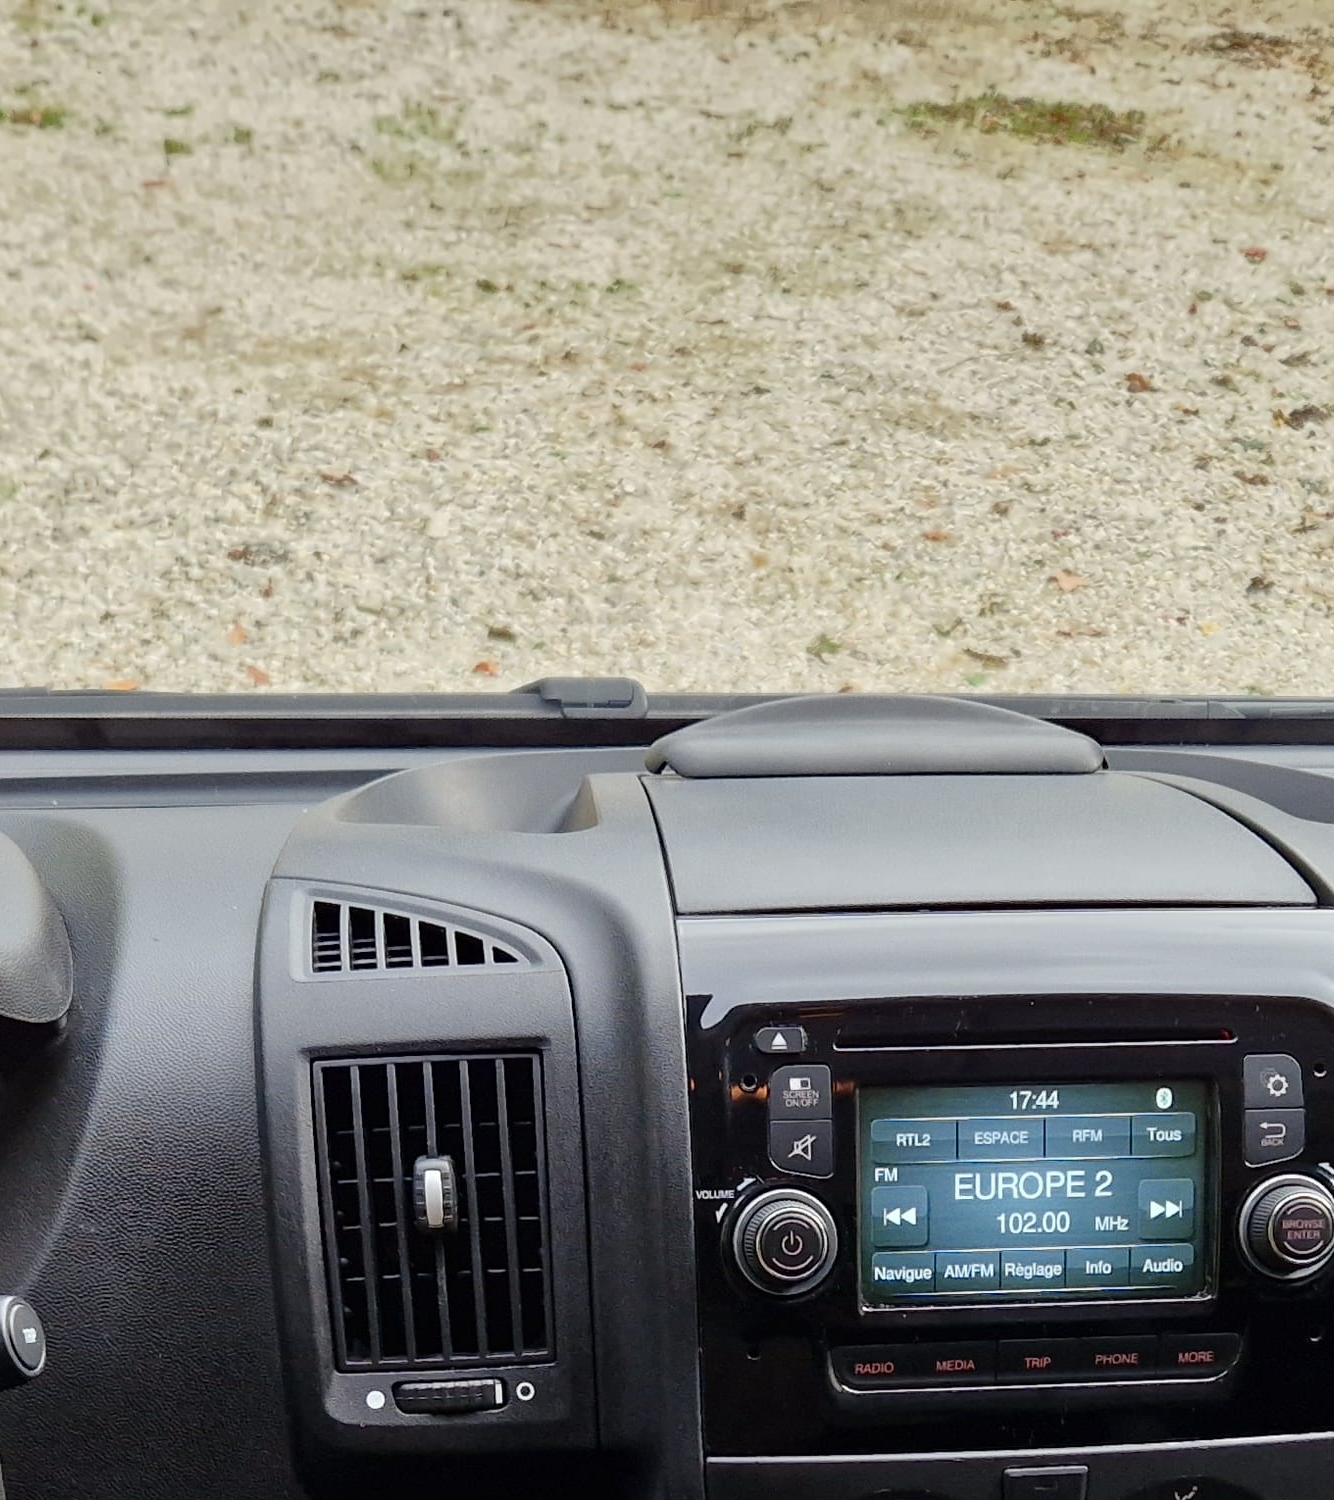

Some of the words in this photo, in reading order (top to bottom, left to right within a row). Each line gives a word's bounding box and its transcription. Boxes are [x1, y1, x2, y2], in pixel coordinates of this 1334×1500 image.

[782, 1089, 820, 1100] SCREEN
[1009, 1090, 1059, 1110] 17:44
[785, 1098, 819, 1108] ON/OFF
[896, 1133, 931, 1147] RTL2
[974, 1130, 1029, 1146] ESPACE
[1072, 1129, 1103, 1143] RFM
[1147, 1127, 1182, 1142] Tous
[874, 1168, 898, 1182] FM
[954, 1170, 1086, 1200] EUROPE
[1094, 1170, 1113, 1197] 2
[695, 1189, 735, 1200] VOLUME
[997, 1211, 1071, 1234] 102.00
[1094, 1216, 1129, 1232] MHz
[944, 1263, 994, 1279] AM/FM
[1085, 1260, 1112, 1275] Info
[1142, 1258, 1184, 1274] Audio
[874, 1266, 932, 1284] Navigue
[1024, 1356, 1052, 1369] TRIP
[1094, 1352, 1139, 1366] PHONE
[1178, 1351, 1215, 1364] MORE
[854, 1361, 895, 1375] RADIO
[936, 1359, 976, 1372] MEDIA
